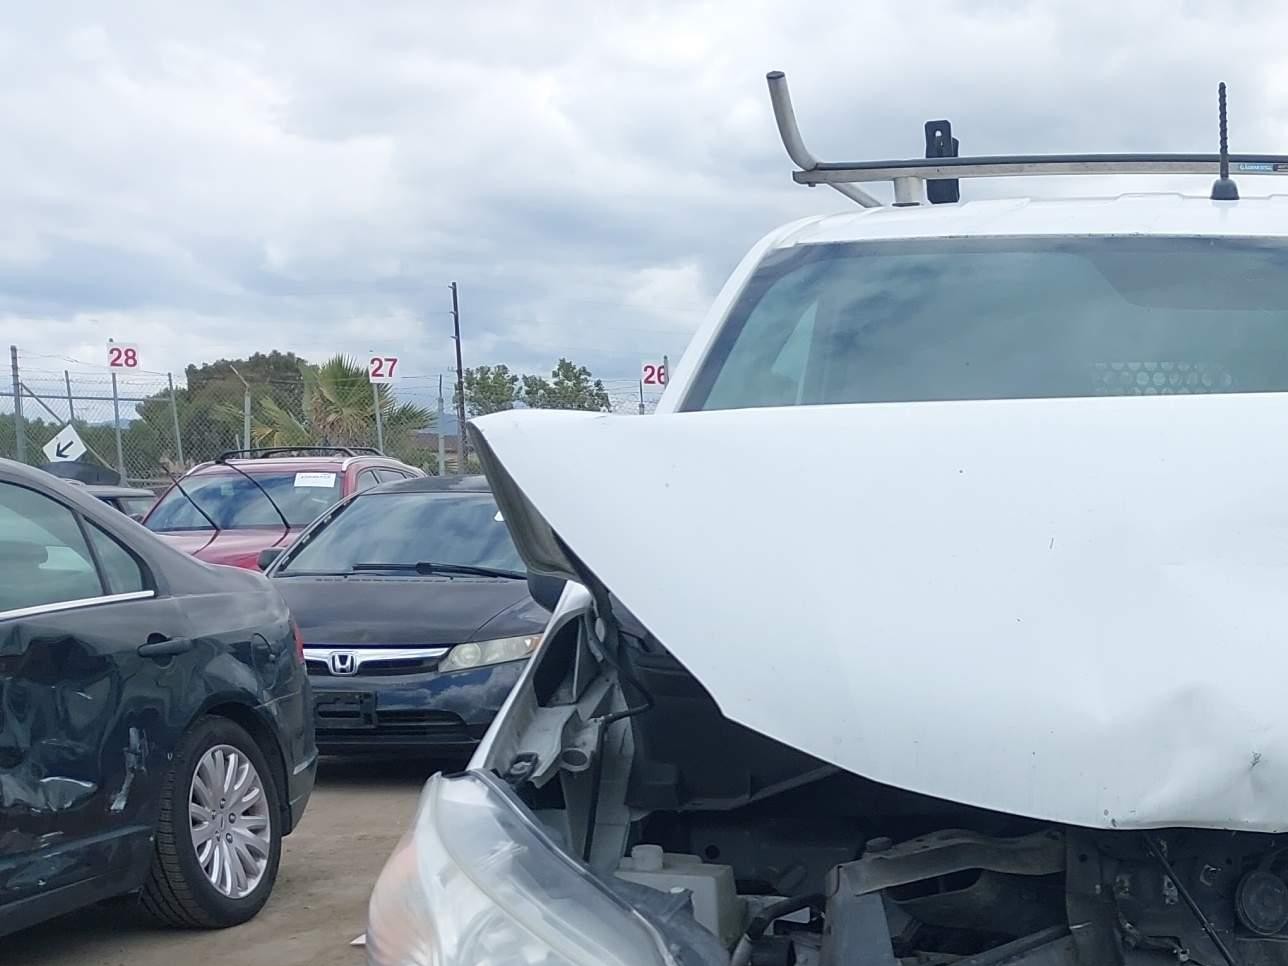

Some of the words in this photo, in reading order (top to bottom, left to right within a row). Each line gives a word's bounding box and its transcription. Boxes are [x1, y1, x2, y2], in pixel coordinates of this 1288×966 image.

[109, 347, 138, 367] 28
[370, 357, 398, 378] 27
[643, 364, 665, 385] 26
